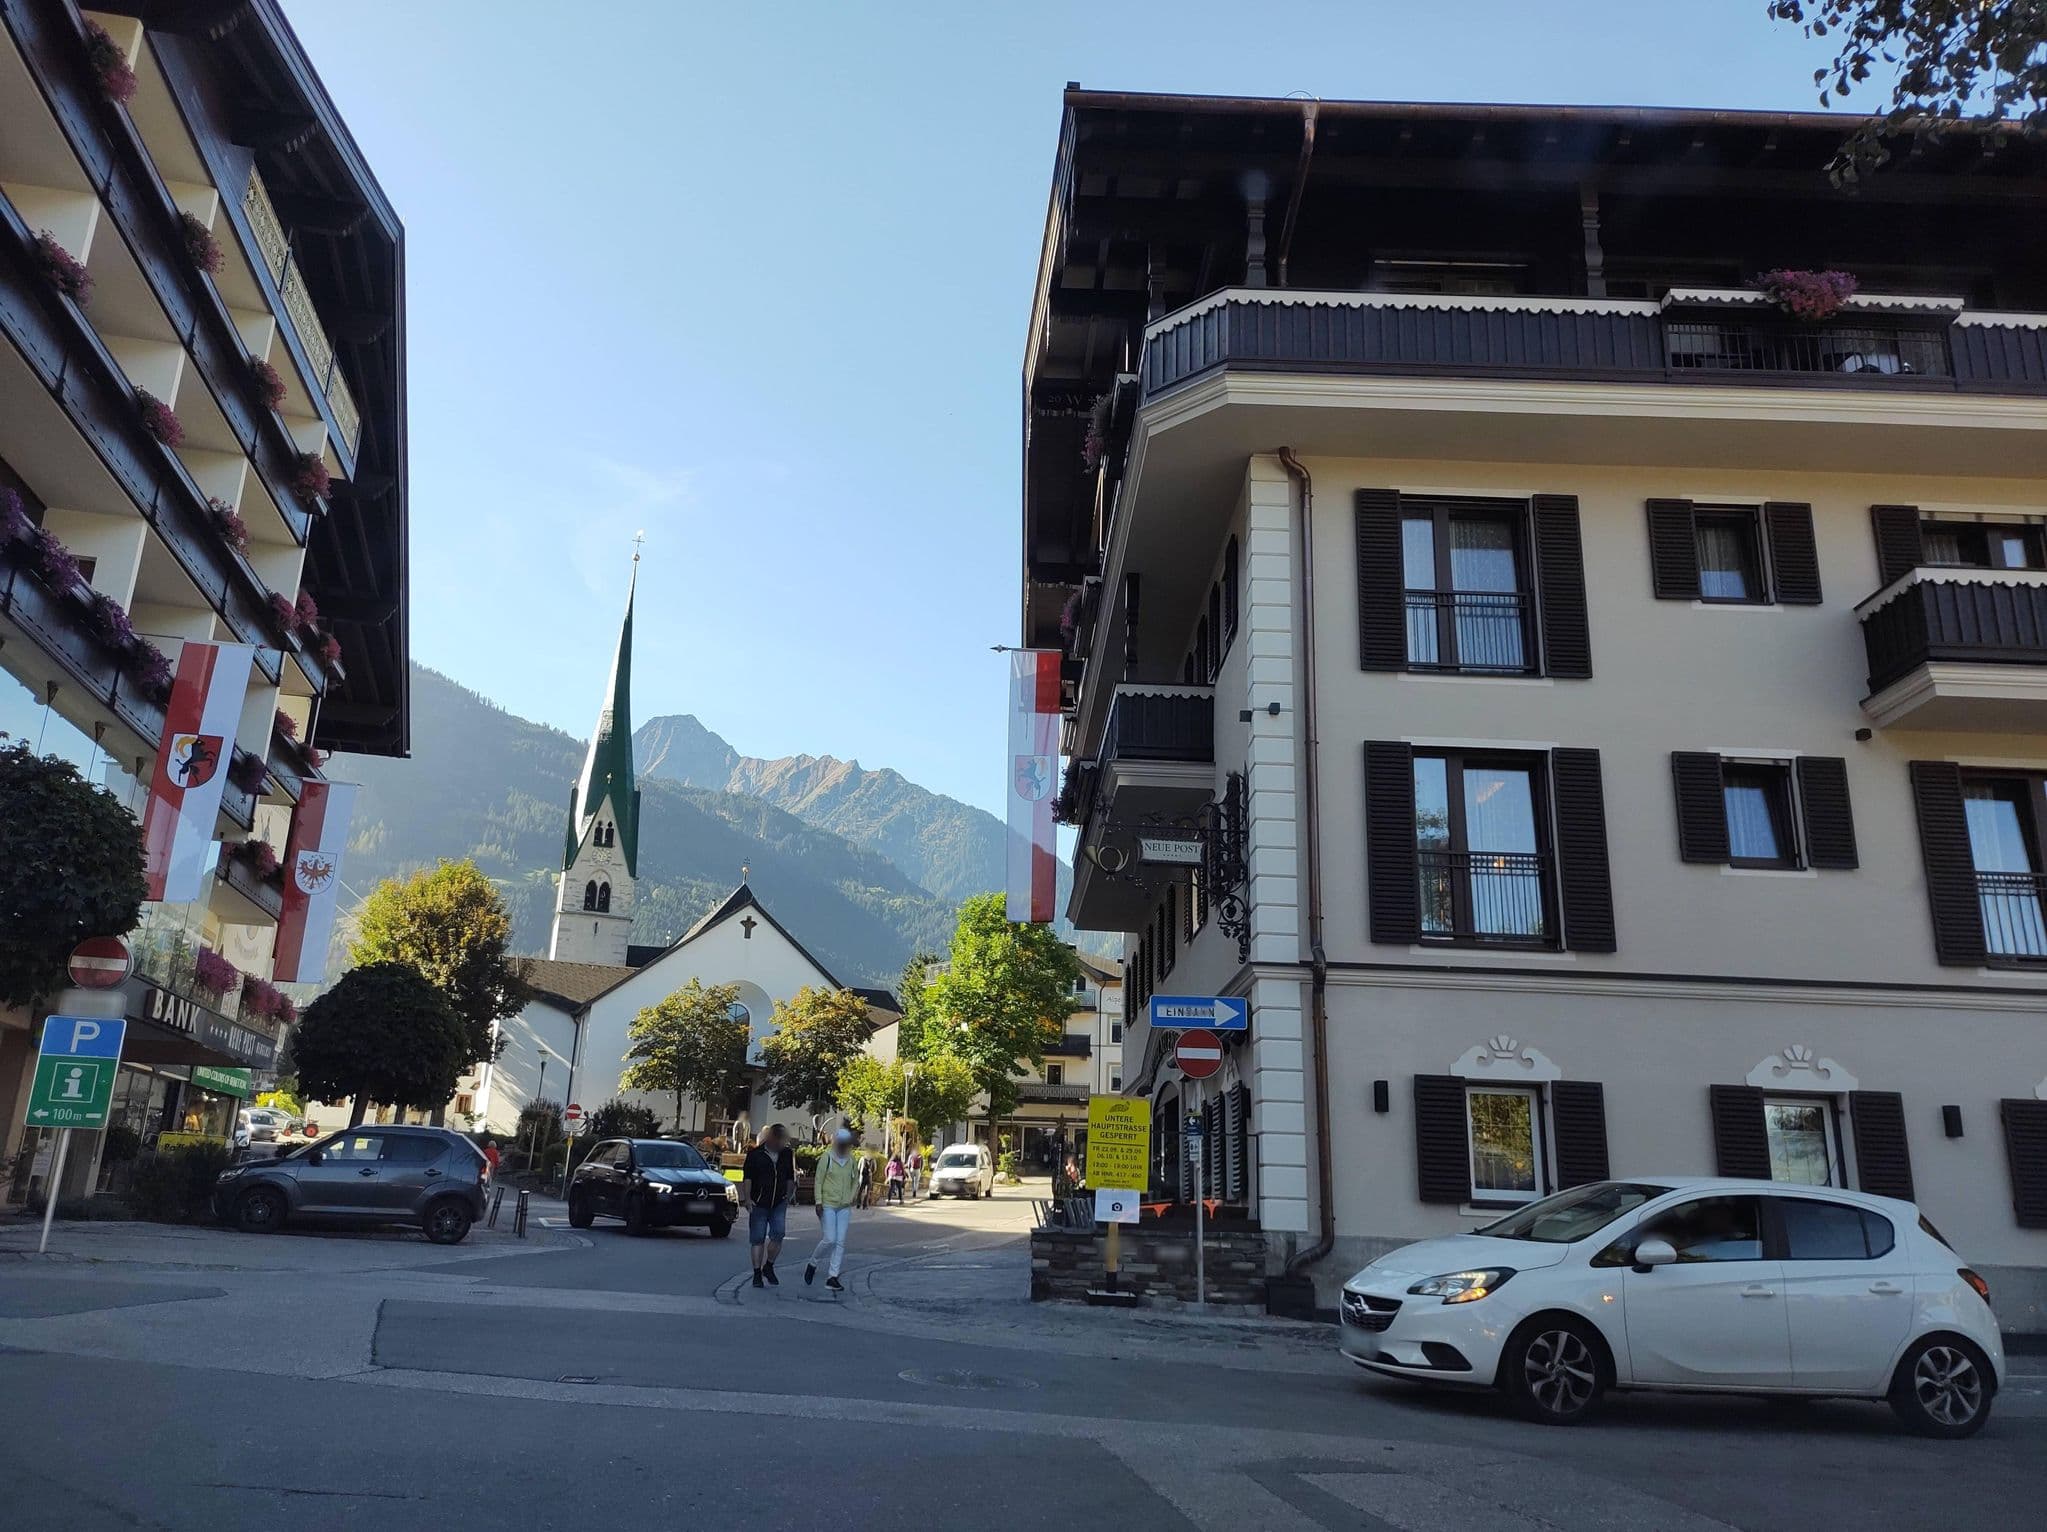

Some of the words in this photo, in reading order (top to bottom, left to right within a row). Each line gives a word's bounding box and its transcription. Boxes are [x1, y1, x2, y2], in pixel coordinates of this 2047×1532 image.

[1144, 842, 1171, 852] NEUE
[1174, 844, 1199, 854] POST
[151, 988, 201, 1034] BANK
[1166, 1007, 1215, 1018] EINBAHN
[70, 1021, 101, 1054] P
[1105, 1115, 1134, 1123] UNTERE
[1091, 1122, 1147, 1132] HAUPTSTRASSE
[1100, 1132, 1137, 1140] GESPERRT
